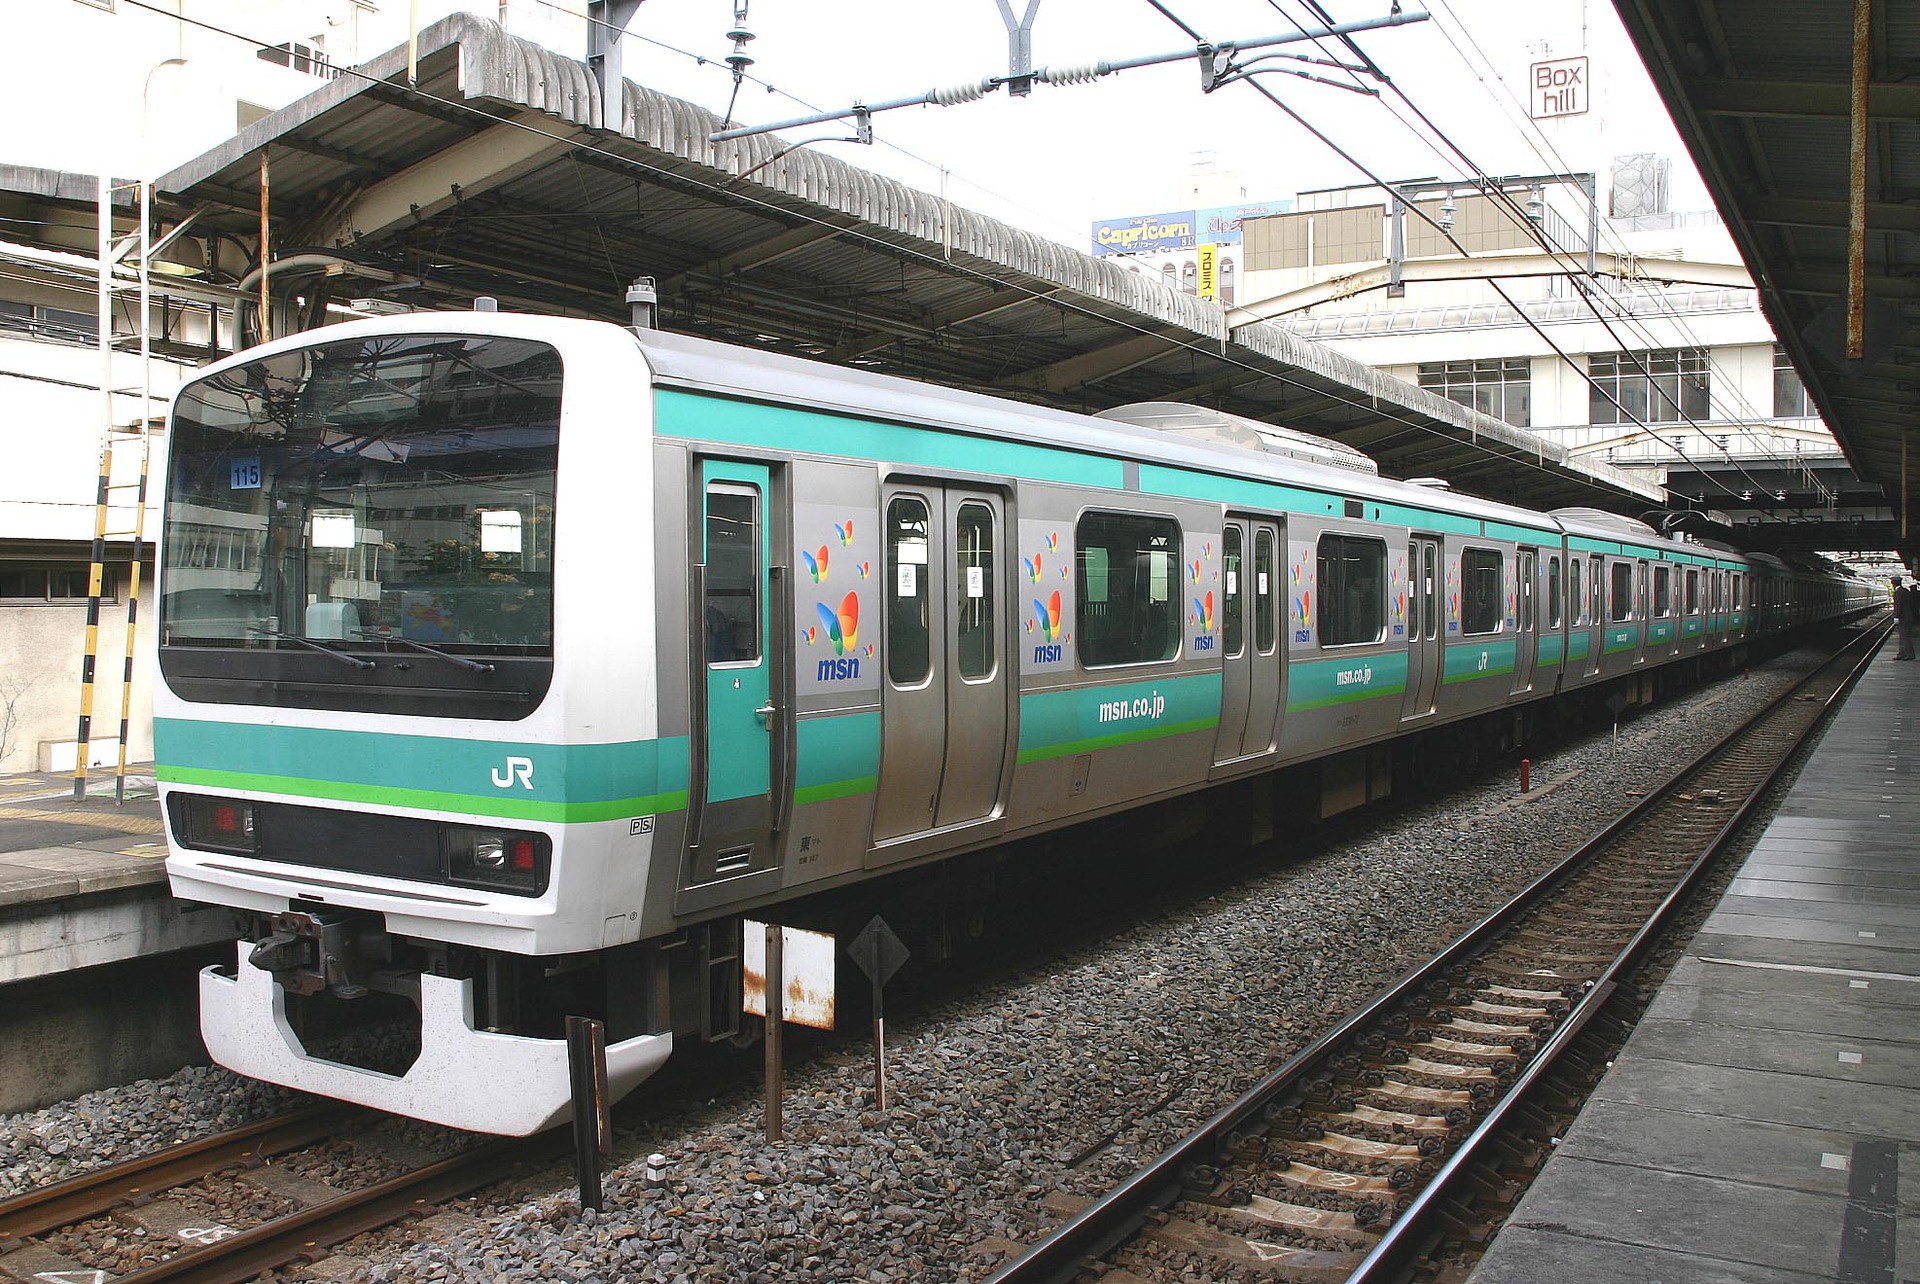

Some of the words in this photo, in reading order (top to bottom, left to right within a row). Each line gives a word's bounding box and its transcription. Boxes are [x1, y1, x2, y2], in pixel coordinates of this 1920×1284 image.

[1537, 67, 1581, 89] Box
[1544, 88, 1575, 113] hill
[1097, 223, 1190, 246] Capricorn
[234, 466, 259, 486] 115
[1194, 635, 1213, 650] msn
[1295, 629, 1310, 643] msn
[1034, 644, 1062, 664] msn
[1478, 651, 1488, 671] JR
[817, 658, 860, 681] msn
[1336, 664, 1372, 686] msn.co.jp
[1099, 690, 1165, 723] msn.co.jp
[491, 756, 534, 790] JR
